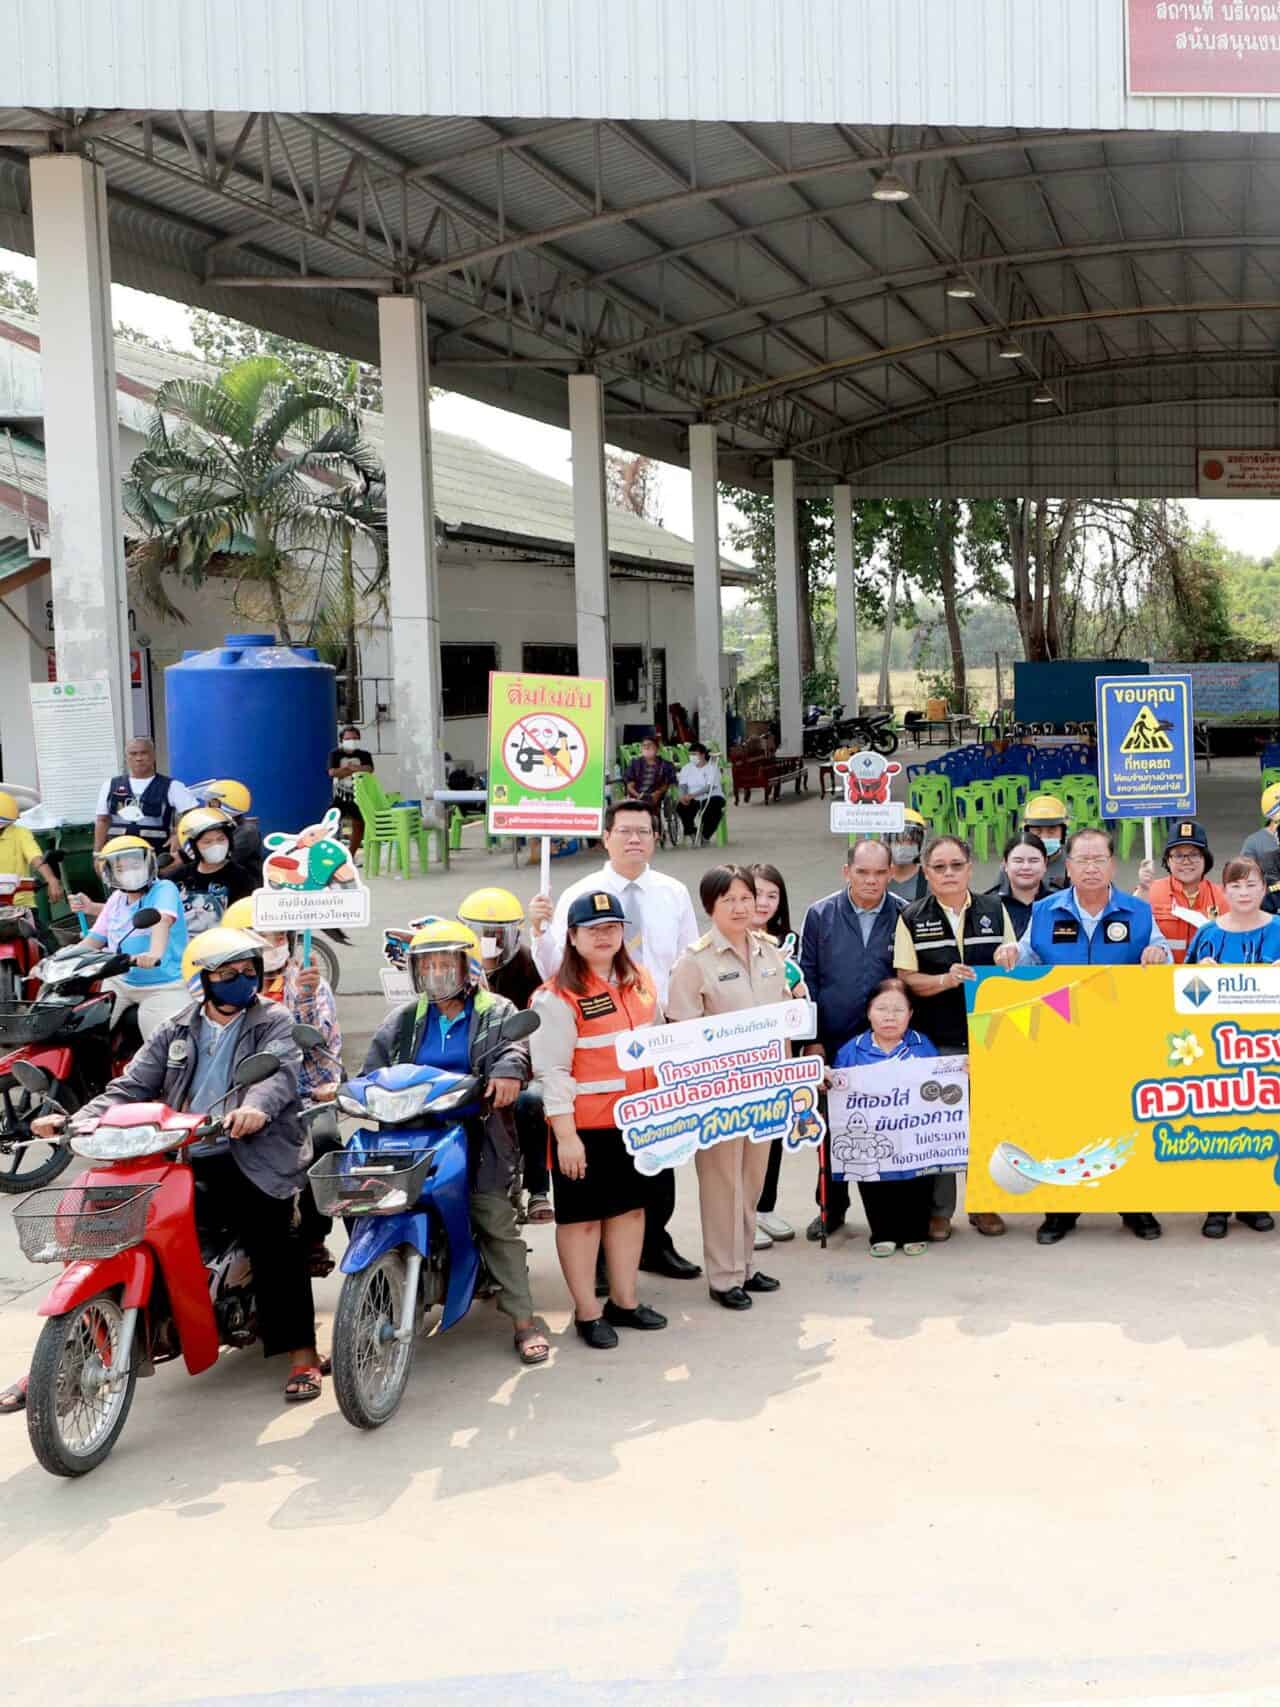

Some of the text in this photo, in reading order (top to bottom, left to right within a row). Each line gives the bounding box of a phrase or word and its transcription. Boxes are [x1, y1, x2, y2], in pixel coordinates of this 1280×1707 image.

[1155, 0, 1214, 21] สถานที
[1114, 688, 1175, 709] ขอบคุณ
[1125, 754, 1171, 773] ที่หยุดรถ
[1217, 973, 1261, 992] คปภ.
[663, 1042, 780, 1083] โครงการรณรงค์
[622, 1061, 818, 1121] ความปลอดภัยทางถนน
[846, 1087, 911, 1110] ขี่ต้องใส่
[875, 1110, 964, 1132] ขับต้องคาด
[915, 1130, 966, 1146] ไม่ประมาท
[1158, 1127, 1275, 1157] ในช่วงเทศกาล
